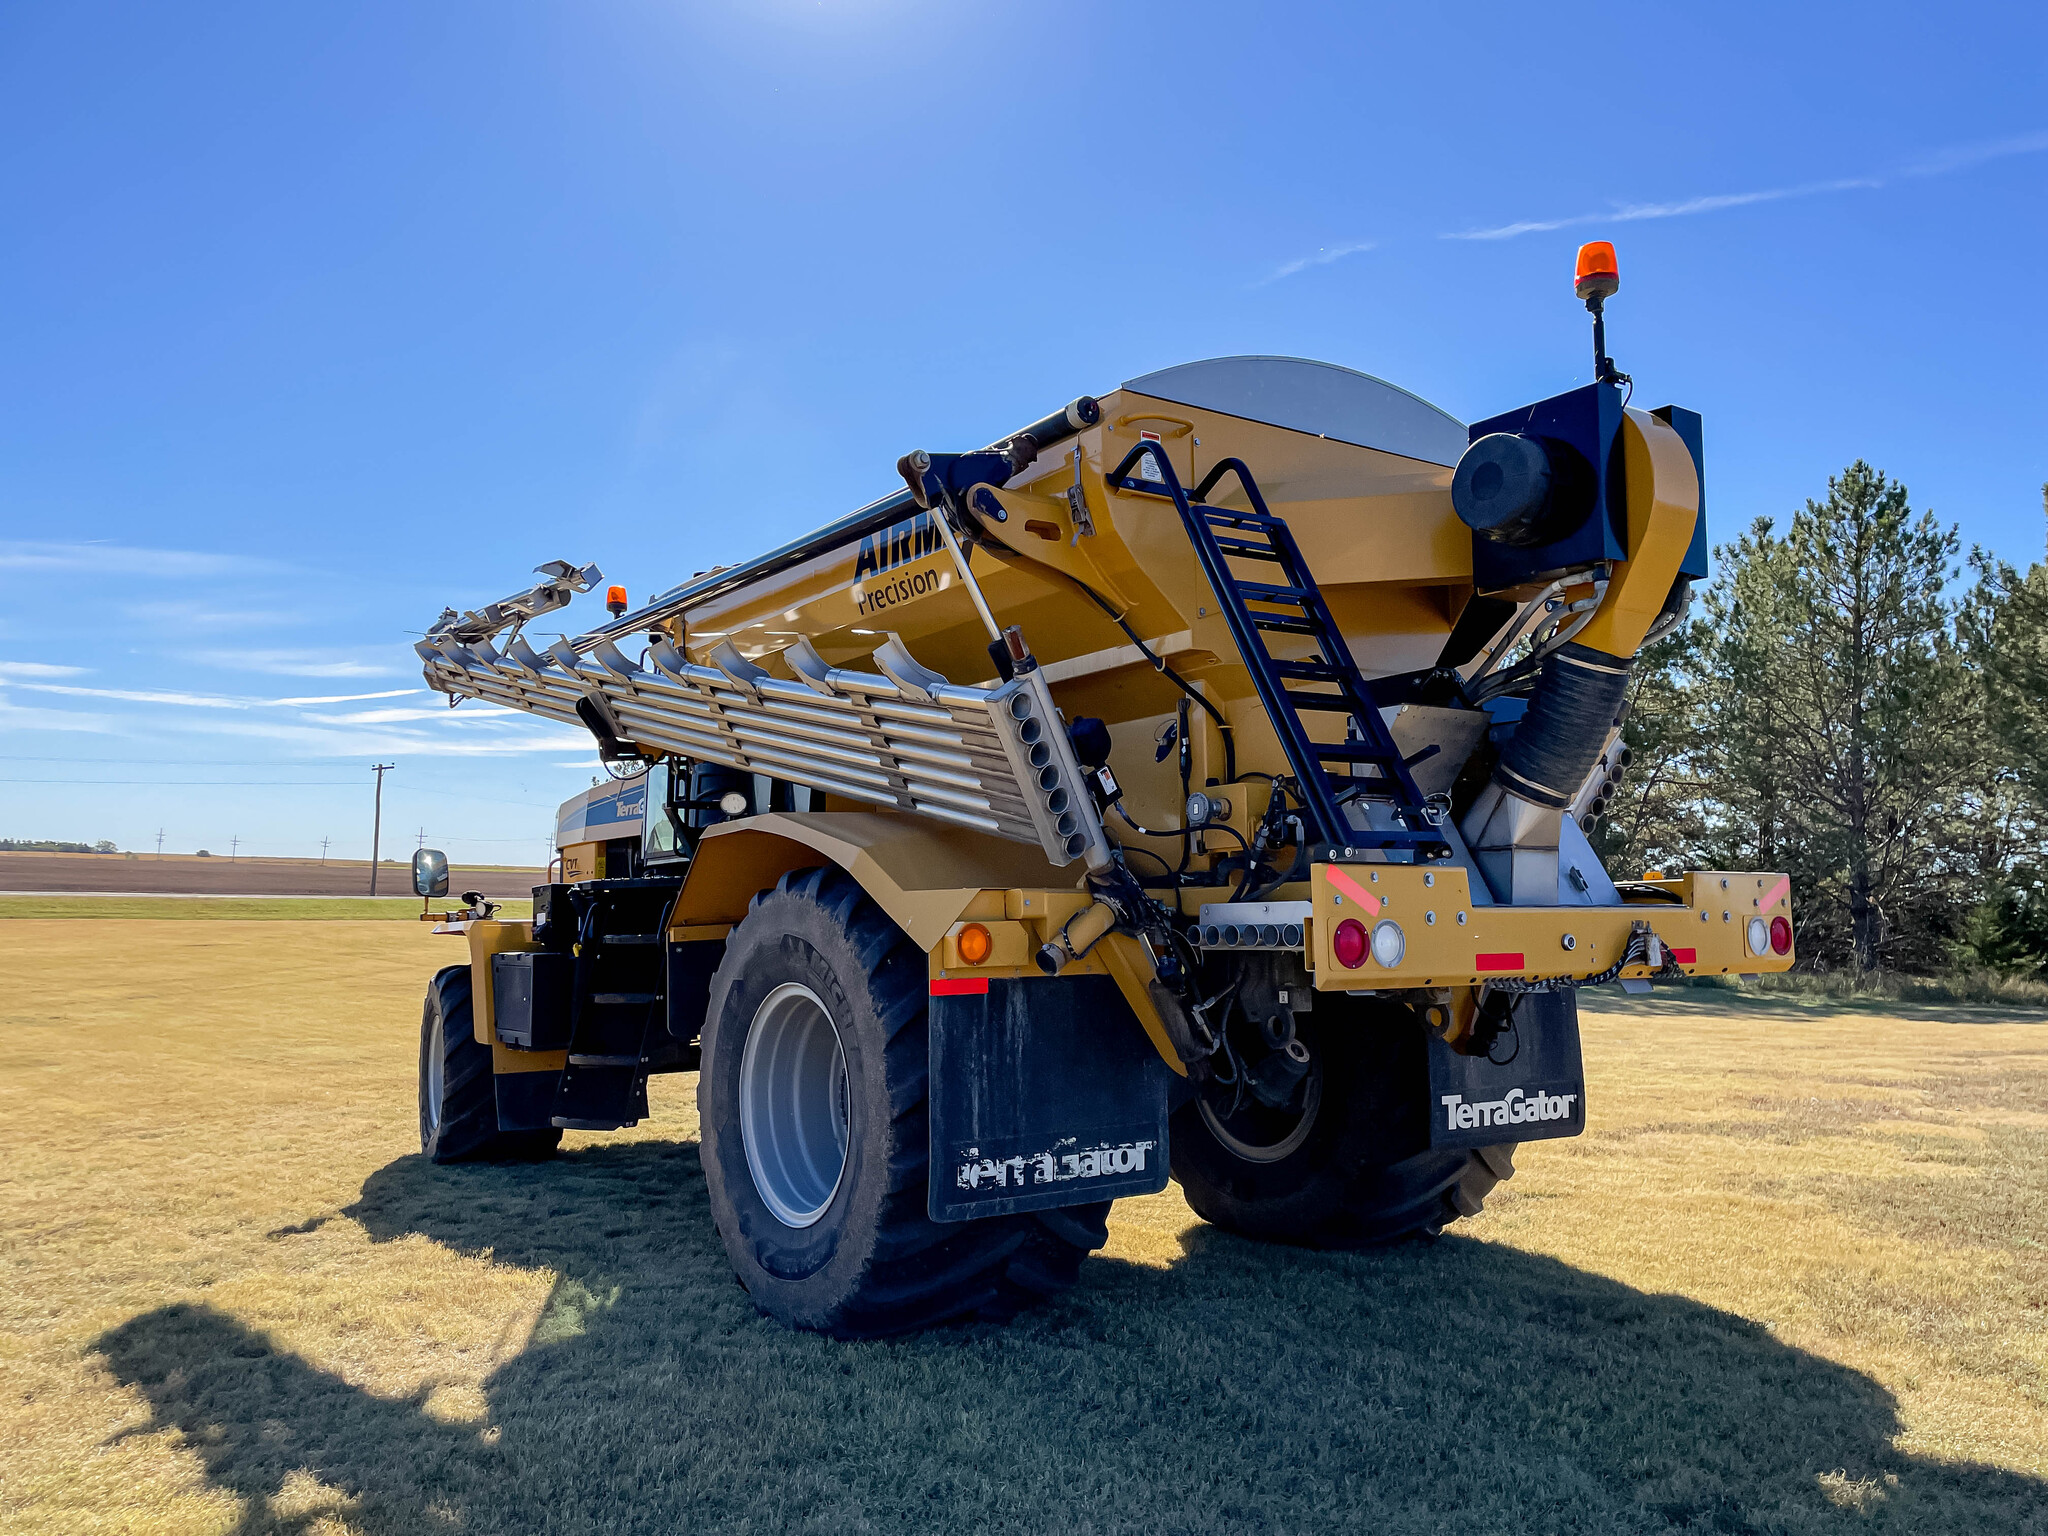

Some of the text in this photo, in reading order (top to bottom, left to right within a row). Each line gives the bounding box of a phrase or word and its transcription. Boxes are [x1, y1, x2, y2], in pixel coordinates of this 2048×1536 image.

[853, 511, 947, 584] AIRM
[857, 568, 940, 616] Precision
[616, 797, 645, 817] TerraG
[566, 858, 578, 870] CVT
[1441, 1087, 1575, 1130] TerraGator
